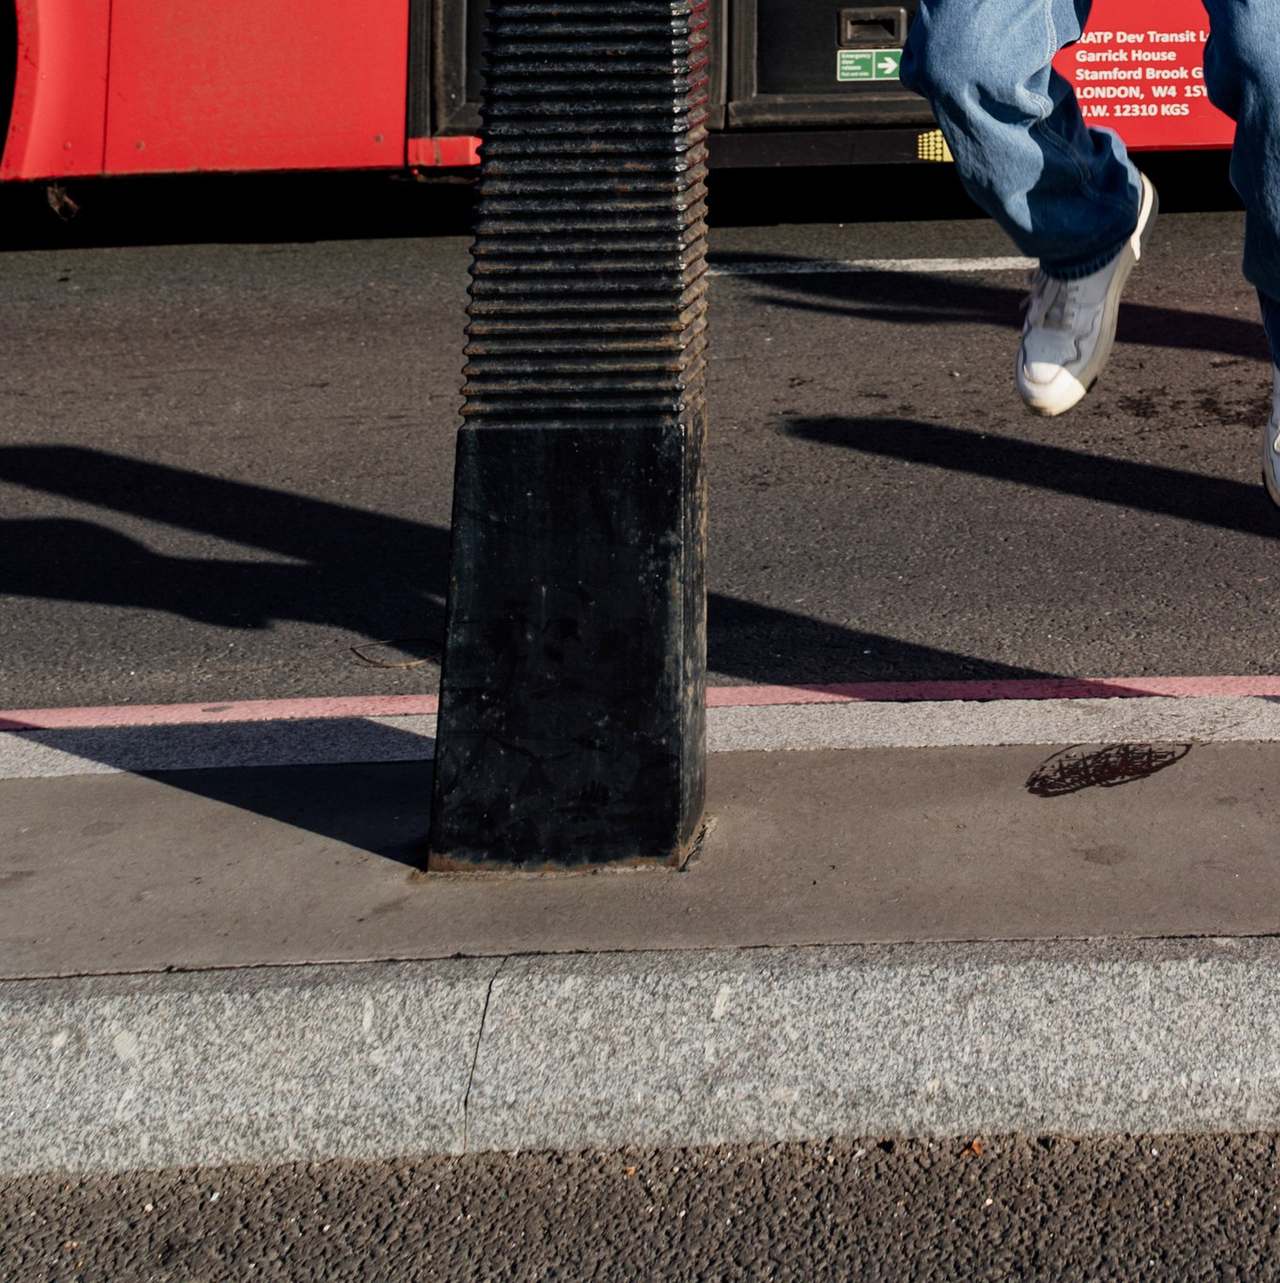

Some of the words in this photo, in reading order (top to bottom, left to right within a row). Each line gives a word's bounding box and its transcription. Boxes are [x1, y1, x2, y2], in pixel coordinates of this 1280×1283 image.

[1116, 31, 1145, 43] Dev
[1147, 30, 1197, 43] Transit
[1075, 50, 1128, 62] Garrick
[1131, 49, 1177, 62] House
[1075, 67, 1142, 81] Stamford
[1146, 67, 1188, 80] Brook
[1076, 86, 1145, 100] LONDON,
[1151, 86, 1177, 98] W4
[1113, 104, 1158, 117] 12310
[1161, 103, 1190, 116] KGS
